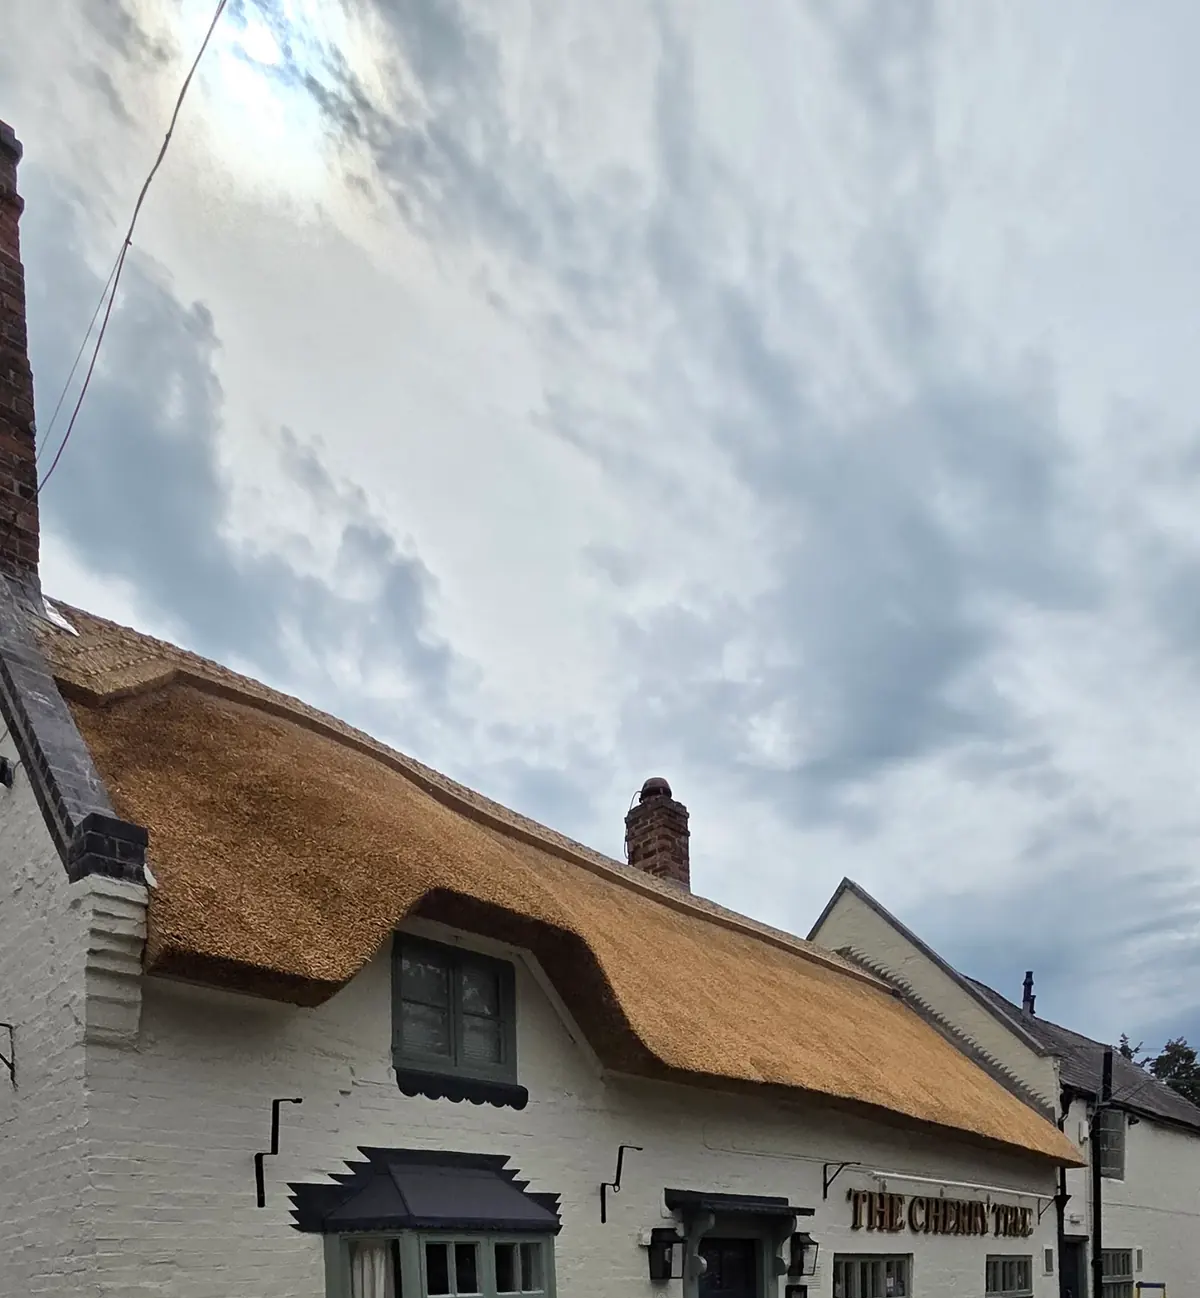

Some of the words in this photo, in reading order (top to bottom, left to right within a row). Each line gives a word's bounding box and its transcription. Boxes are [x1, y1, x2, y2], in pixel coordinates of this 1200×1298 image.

[847, 1188, 906, 1232] THE
[908, 1196, 994, 1236] CHERRY
[990, 1202, 1034, 1237] TREE
